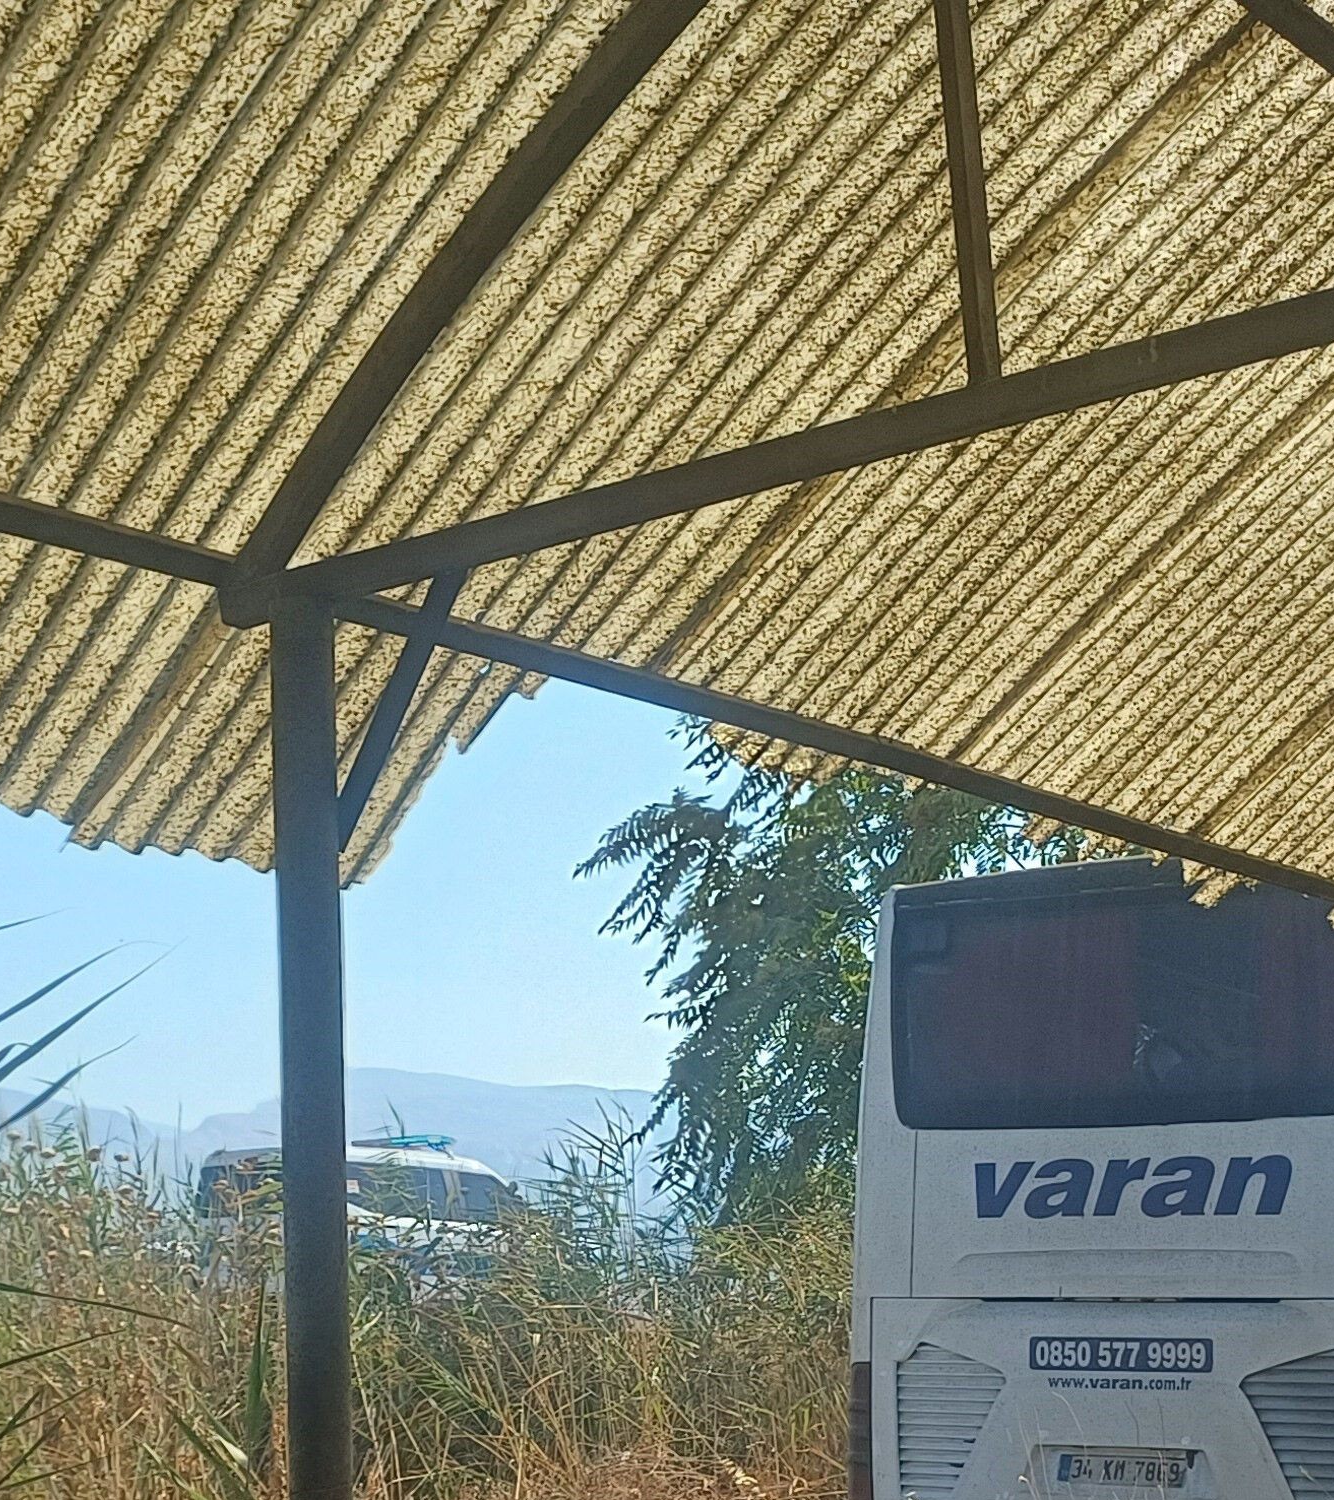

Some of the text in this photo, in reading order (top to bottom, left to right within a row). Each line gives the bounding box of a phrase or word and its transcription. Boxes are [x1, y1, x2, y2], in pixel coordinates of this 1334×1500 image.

[974, 1154, 1293, 1219] varan
[1035, 1340, 1206, 1369] 0850 577 9999
[1048, 1377, 1192, 1391] www.varan.com.tr
[1071, 1459, 1093, 1479] 34
[1102, 1459, 1126, 1481] XM
